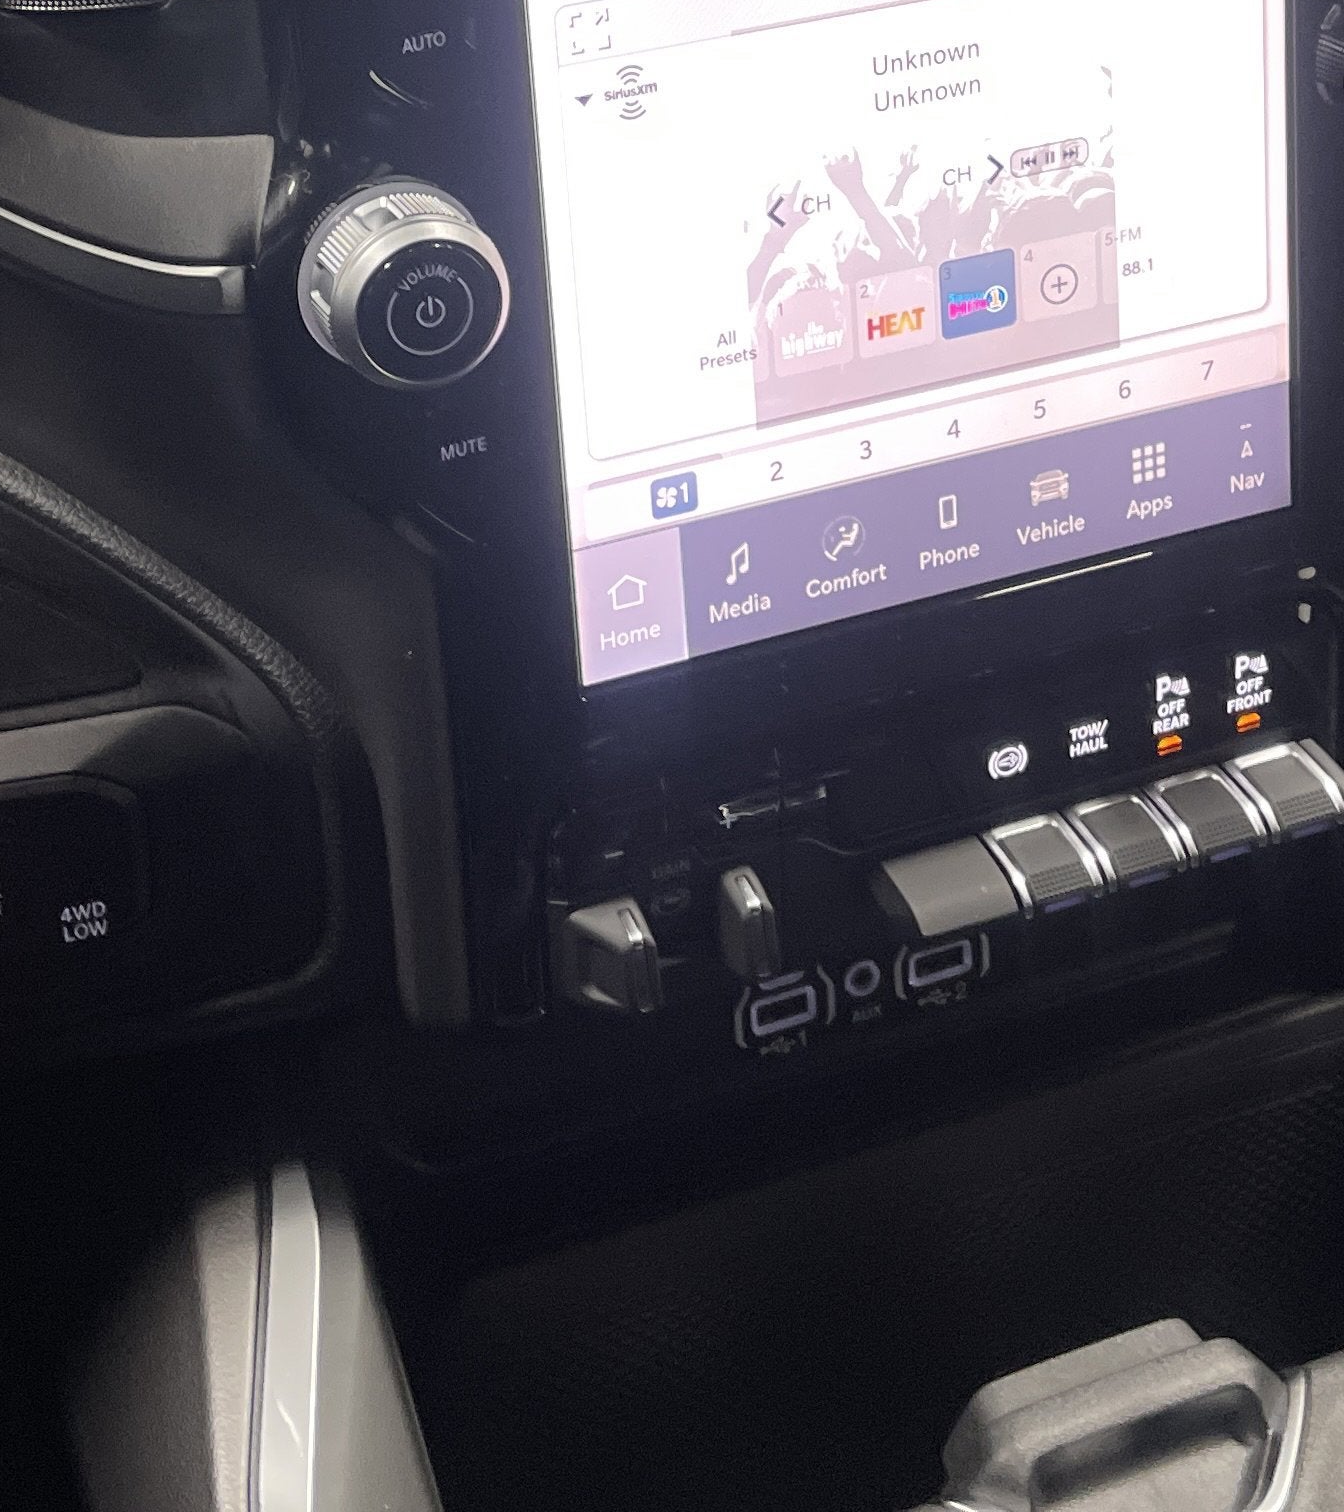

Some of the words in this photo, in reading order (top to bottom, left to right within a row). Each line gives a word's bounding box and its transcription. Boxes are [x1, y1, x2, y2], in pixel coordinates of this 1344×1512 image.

[401, 31, 447, 55] AUTO
[872, 41, 981, 75] Unknown
[874, 75, 982, 111] Unknown
[942, 165, 972, 187] CH
[800, 193, 831, 216] CH
[1023, 249, 1034, 263] 4
[1121, 258, 1154, 277] 88.1
[398, 264, 459, 292] VOLUME
[942, 267, 952, 281] 3
[859, 284, 870, 299] 2
[867, 306, 925, 340] HEAT
[716, 330, 737, 347] All
[699, 347, 757, 370] Presets
[769, 461, 784, 482] 2
[859, 440, 873, 460] 3
[947, 419, 961, 439] 4
[1033, 399, 1047, 419] 5
[1118, 379, 1132, 399] 6
[1201, 360, 1215, 381] 7
[440, 436, 488, 462] MUTE
[1229, 471, 1265, 494] Nav
[1126, 494, 1173, 519] Apps
[1016, 515, 1086, 545] Vehicle
[919, 540, 981, 570] Phone
[806, 563, 887, 598] Comfort
[708, 593, 772, 623] Media
[600, 623, 661, 650] Home
[1236, 676, 1264, 695] OFF
[1157, 698, 1186, 718] OFF
[1226, 688, 1273, 714] FRONT
[1069, 719, 1109, 742] TOW/
[1152, 713, 1190, 735] REAR
[1069, 736, 1109, 758] HAUL
[60, 900, 106, 923] 4WD
[62, 919, 108, 943] LOW
